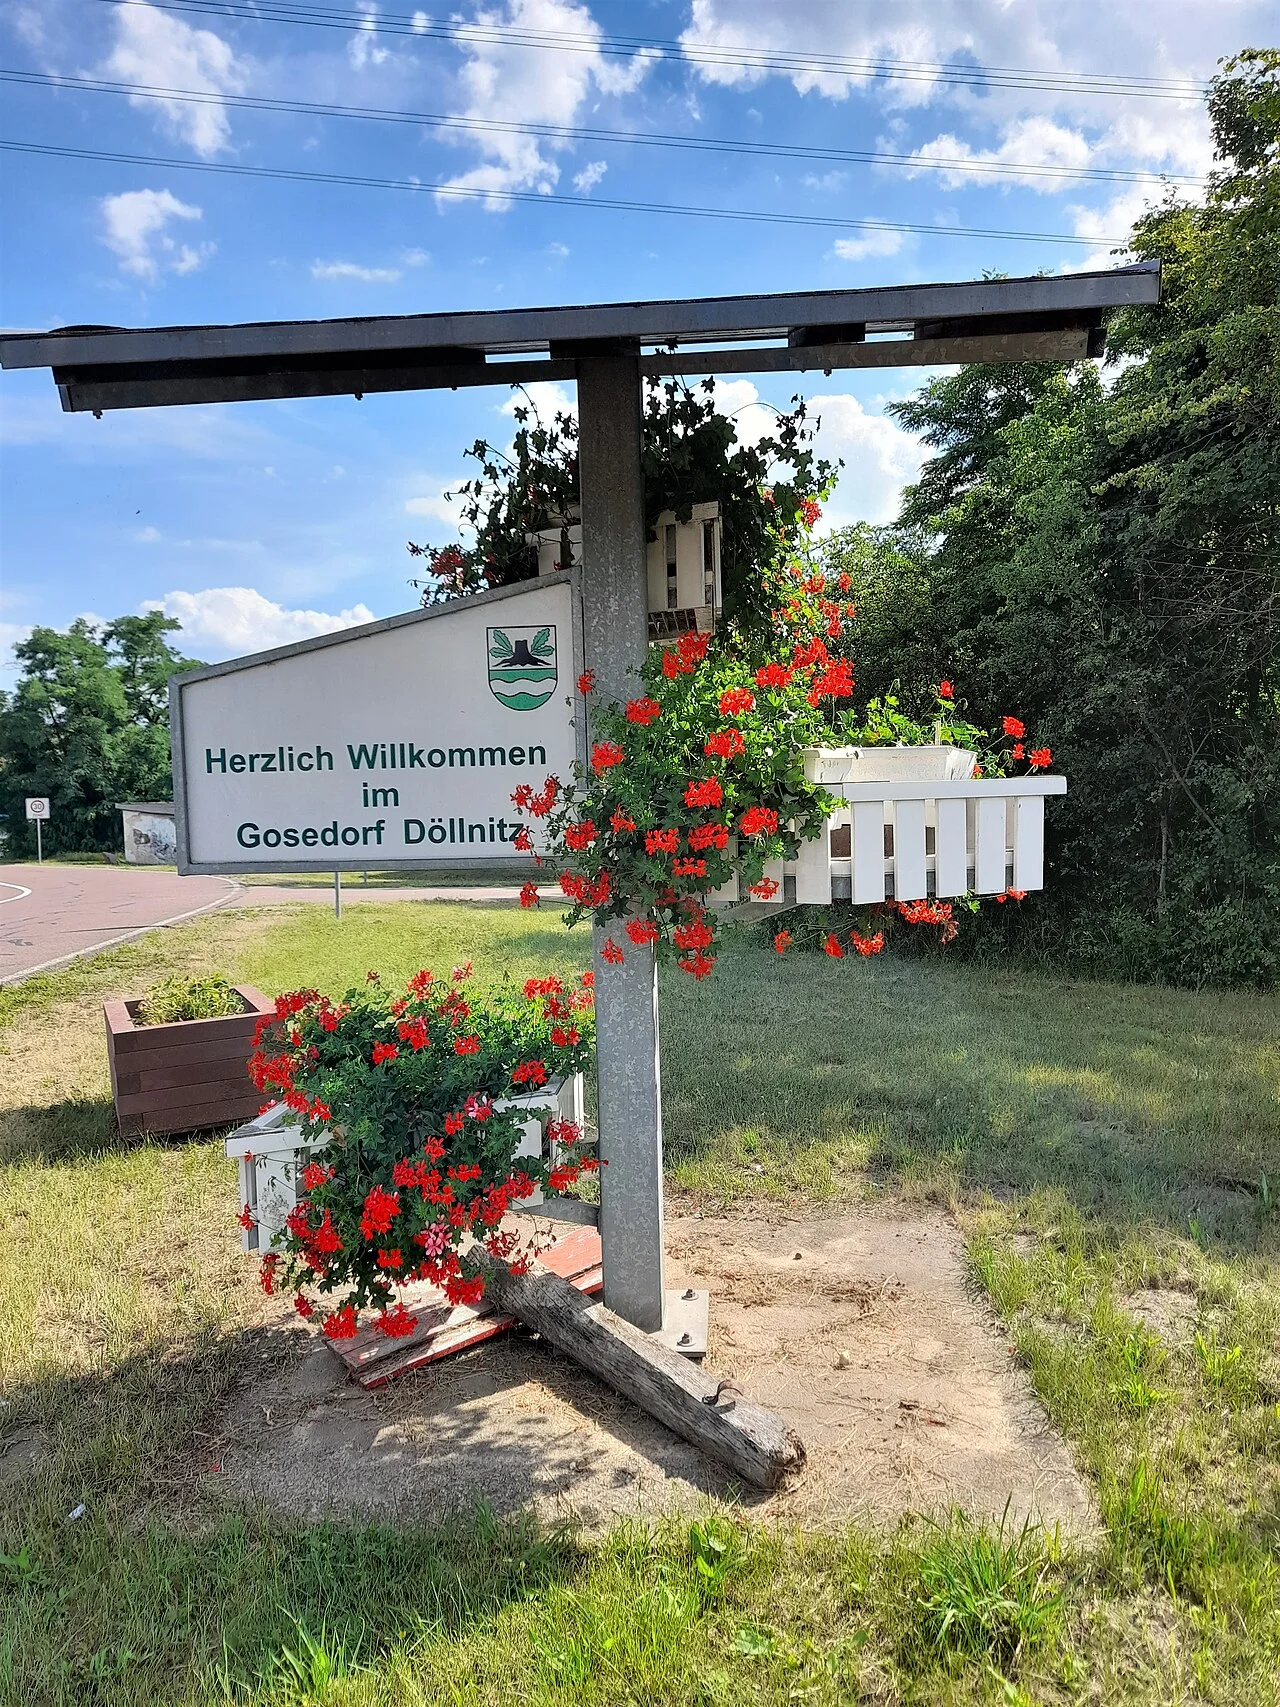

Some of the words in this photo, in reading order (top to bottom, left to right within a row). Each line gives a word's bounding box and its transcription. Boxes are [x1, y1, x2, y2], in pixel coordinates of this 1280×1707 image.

[205, 746, 334, 774] Herzlich
[346, 742, 547, 770] Willkommen
[362, 781, 400, 808] im
[236, 819, 386, 849] Gosedorf
[403, 816, 526, 845] Döllnitz
